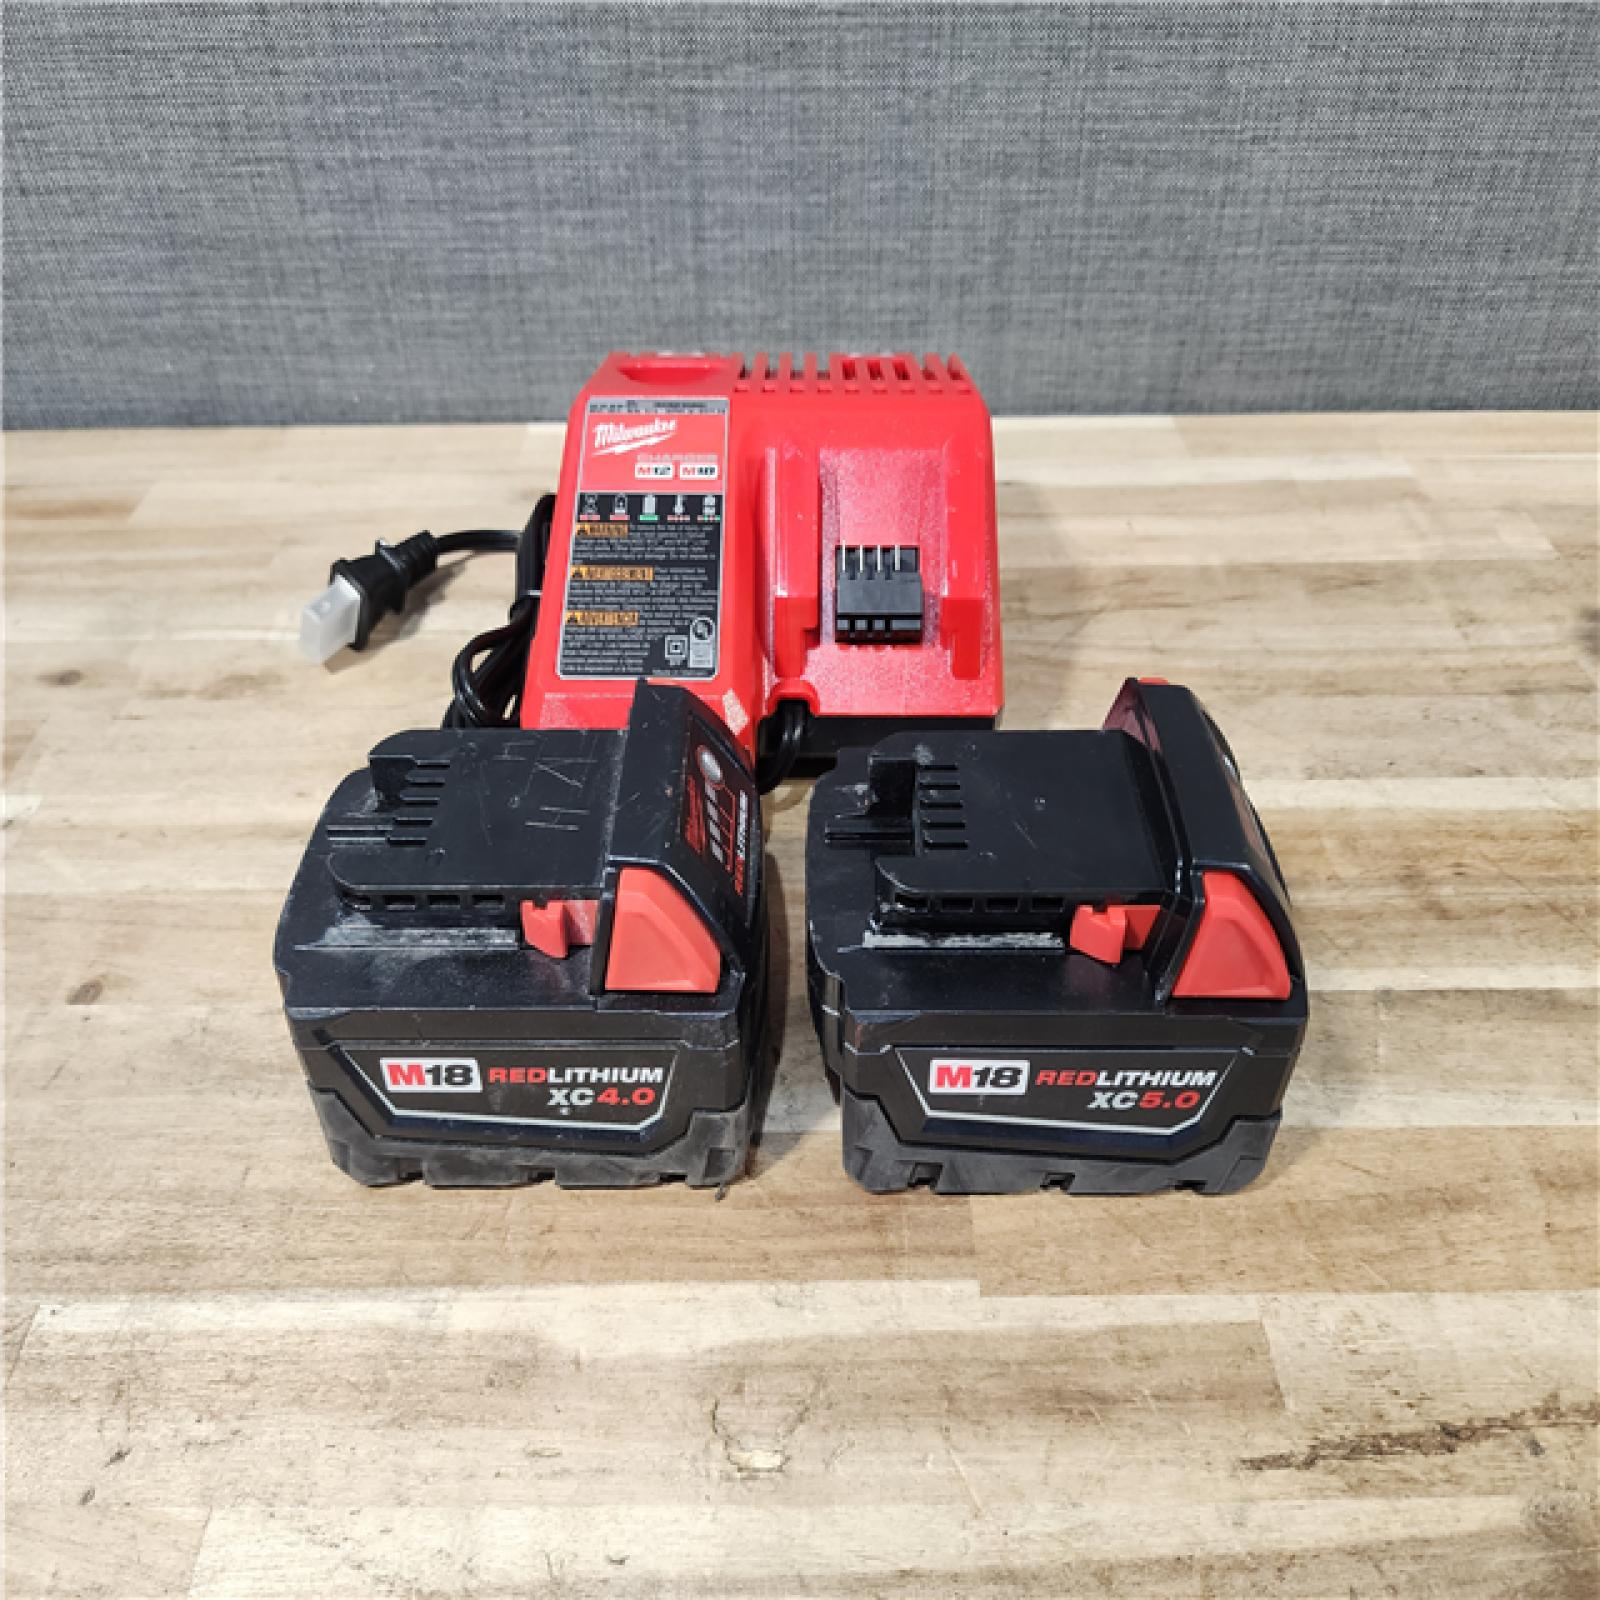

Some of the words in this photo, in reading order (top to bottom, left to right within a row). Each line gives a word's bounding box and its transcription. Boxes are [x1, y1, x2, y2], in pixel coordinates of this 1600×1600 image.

[386, 1063, 474, 1087] M18
[488, 1066, 664, 1084] REDLITHIUM
[935, 1065, 1022, 1089] M18
[1035, 1069, 1218, 1087] REDLITHIUM
[1087, 1090, 1201, 1110] XC5.0
